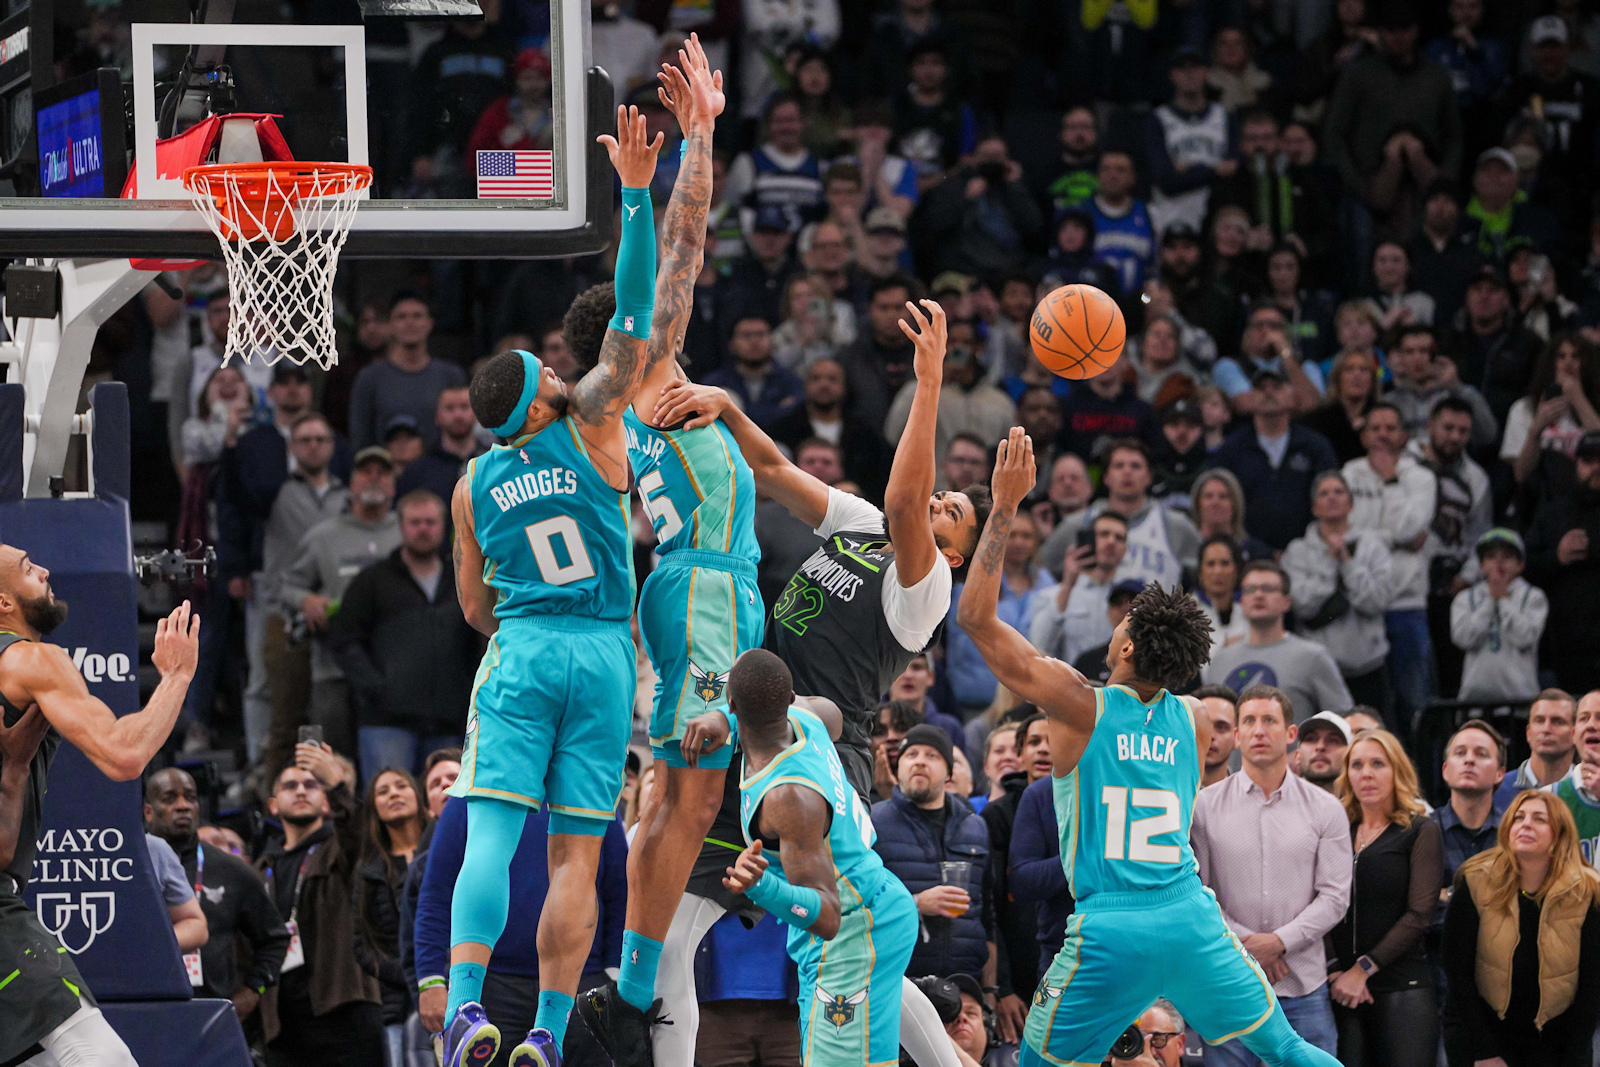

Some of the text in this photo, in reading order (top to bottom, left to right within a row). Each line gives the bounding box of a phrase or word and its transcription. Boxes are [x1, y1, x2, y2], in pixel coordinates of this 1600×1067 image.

[72, 135, 100, 177] ULTRA
[642, 434, 666, 466] JR.
[490, 467, 577, 513] BRIDGES
[637, 468, 684, 545] 5
[524, 514, 596, 586] 0
[774, 573, 824, 636] 32
[62, 647, 131, 683] Vee
[1117, 733, 1179, 766] BLACK
[36, 828, 123, 853] MAYO
[1102, 785, 1181, 864] 12
